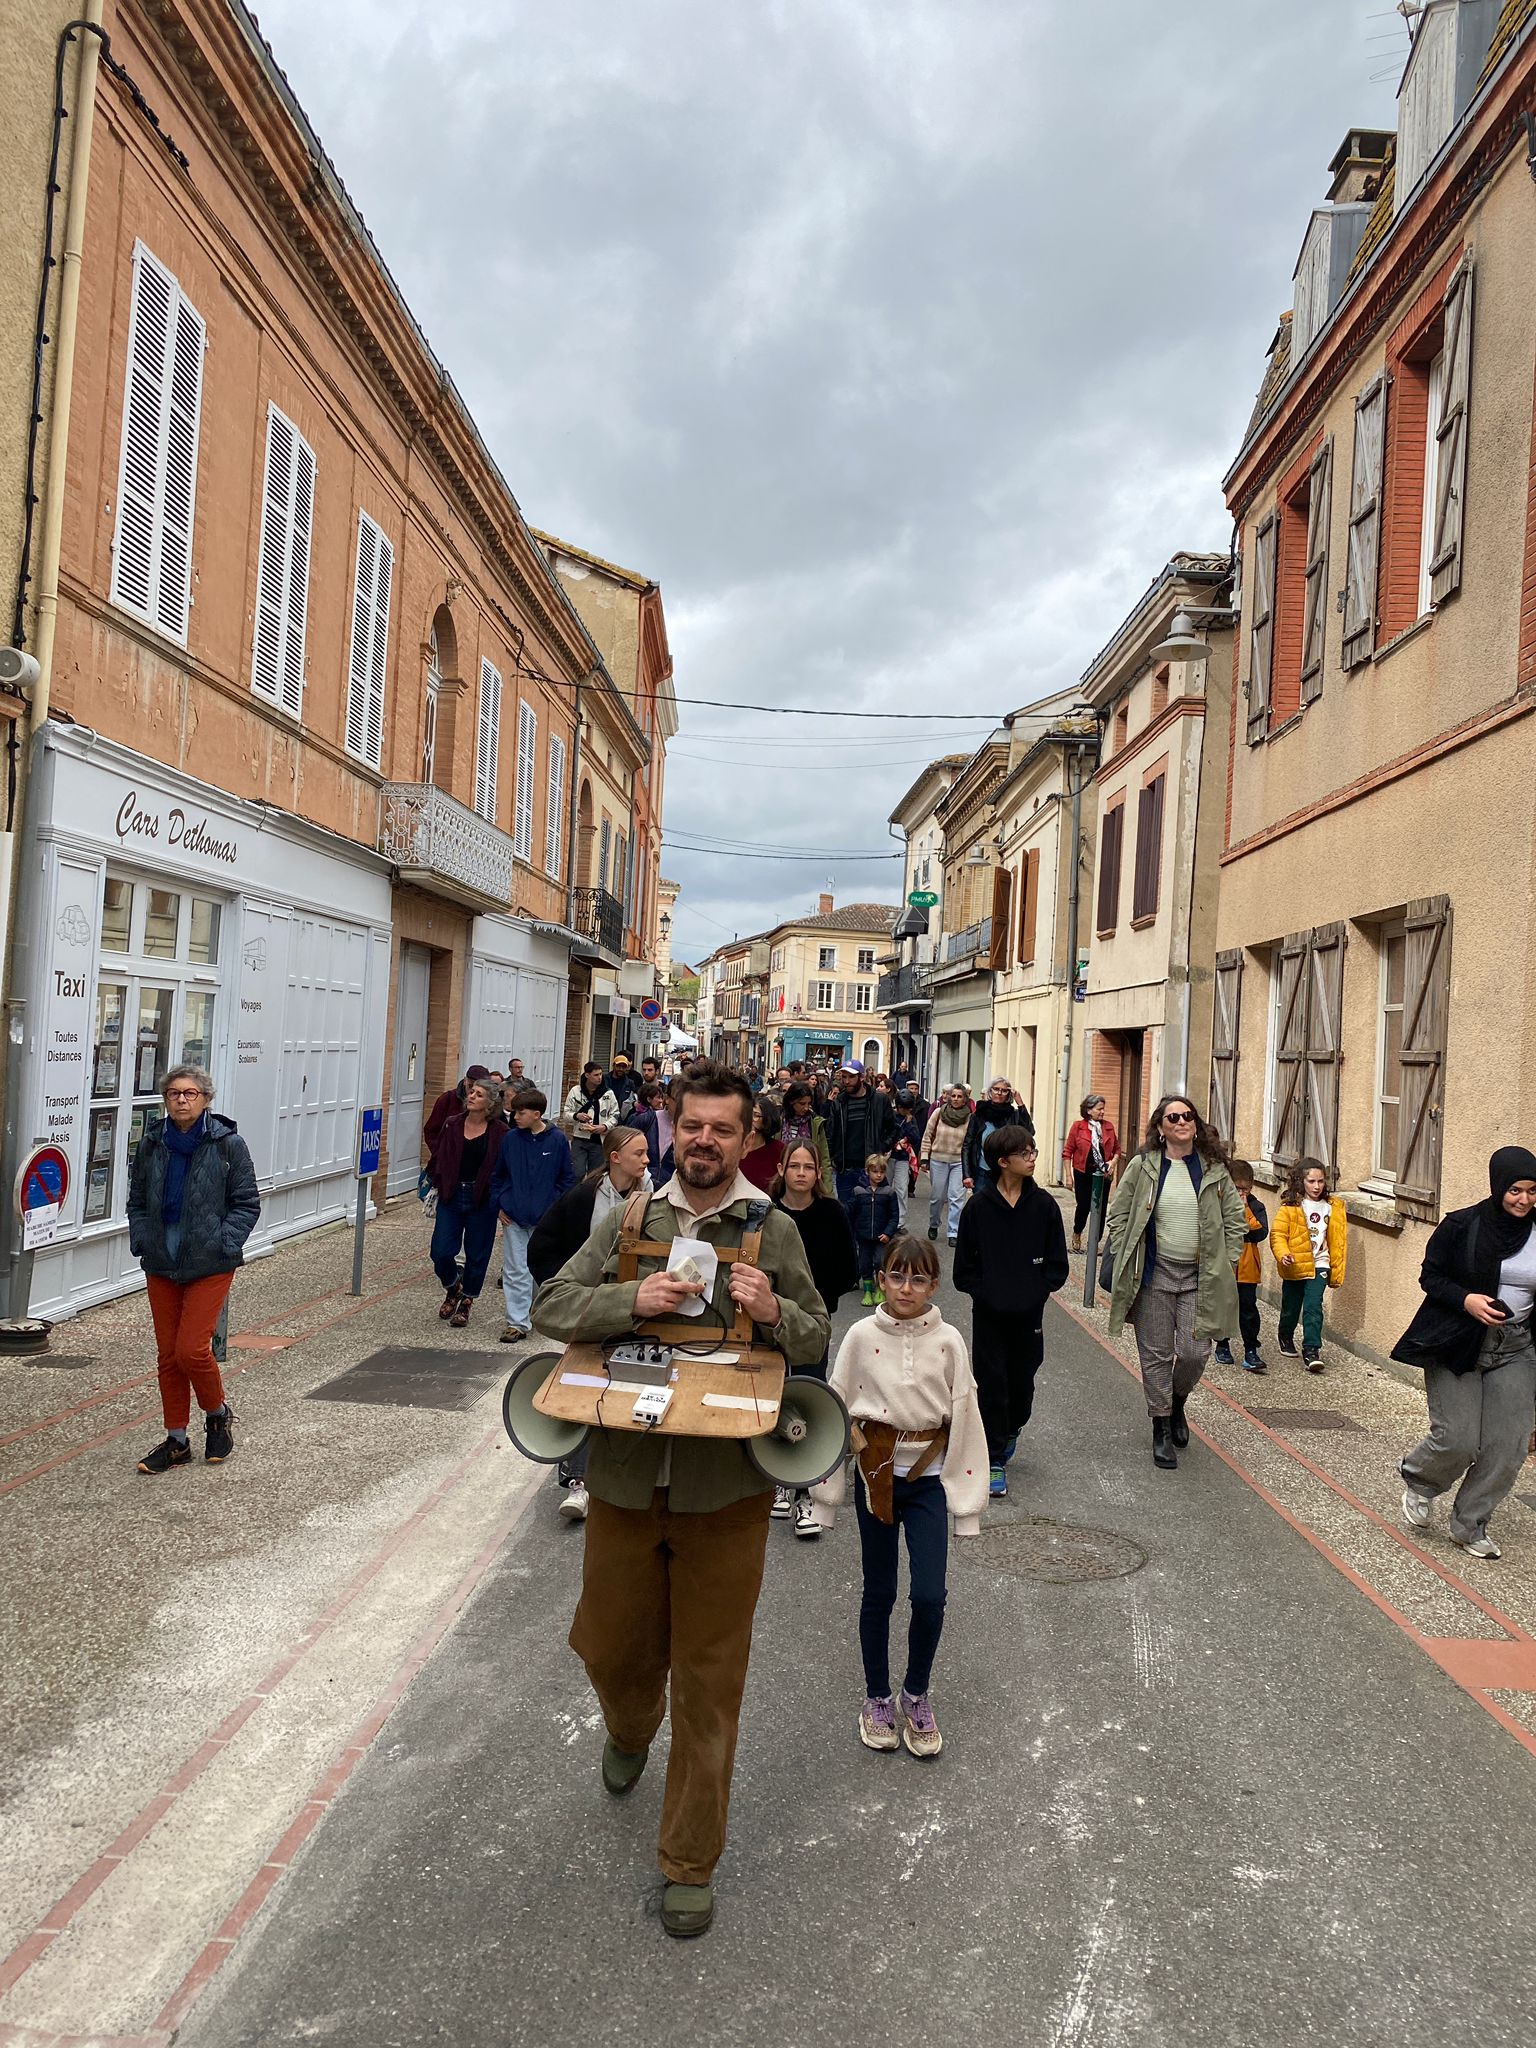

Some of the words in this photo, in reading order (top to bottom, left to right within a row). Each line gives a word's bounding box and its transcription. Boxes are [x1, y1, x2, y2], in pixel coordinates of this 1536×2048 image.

[116, 791, 159, 838] Cars
[168, 808, 237, 863] Dethomas
[55, 970, 85, 998] Taxi
[240, 998, 262, 1012] Voyages
[55, 1030, 78, 1042] Toutes
[813, 1031, 840, 1039] TABAC
[237, 1040, 260, 1049] Excursions
[48, 1050, 82, 1062] Distances
[45, 1094, 79, 1108] Transport
[48, 1113, 73, 1126] Malade
[50, 1131, 70, 1143] Assis
[363, 1130, 380, 1152] TAXIS
